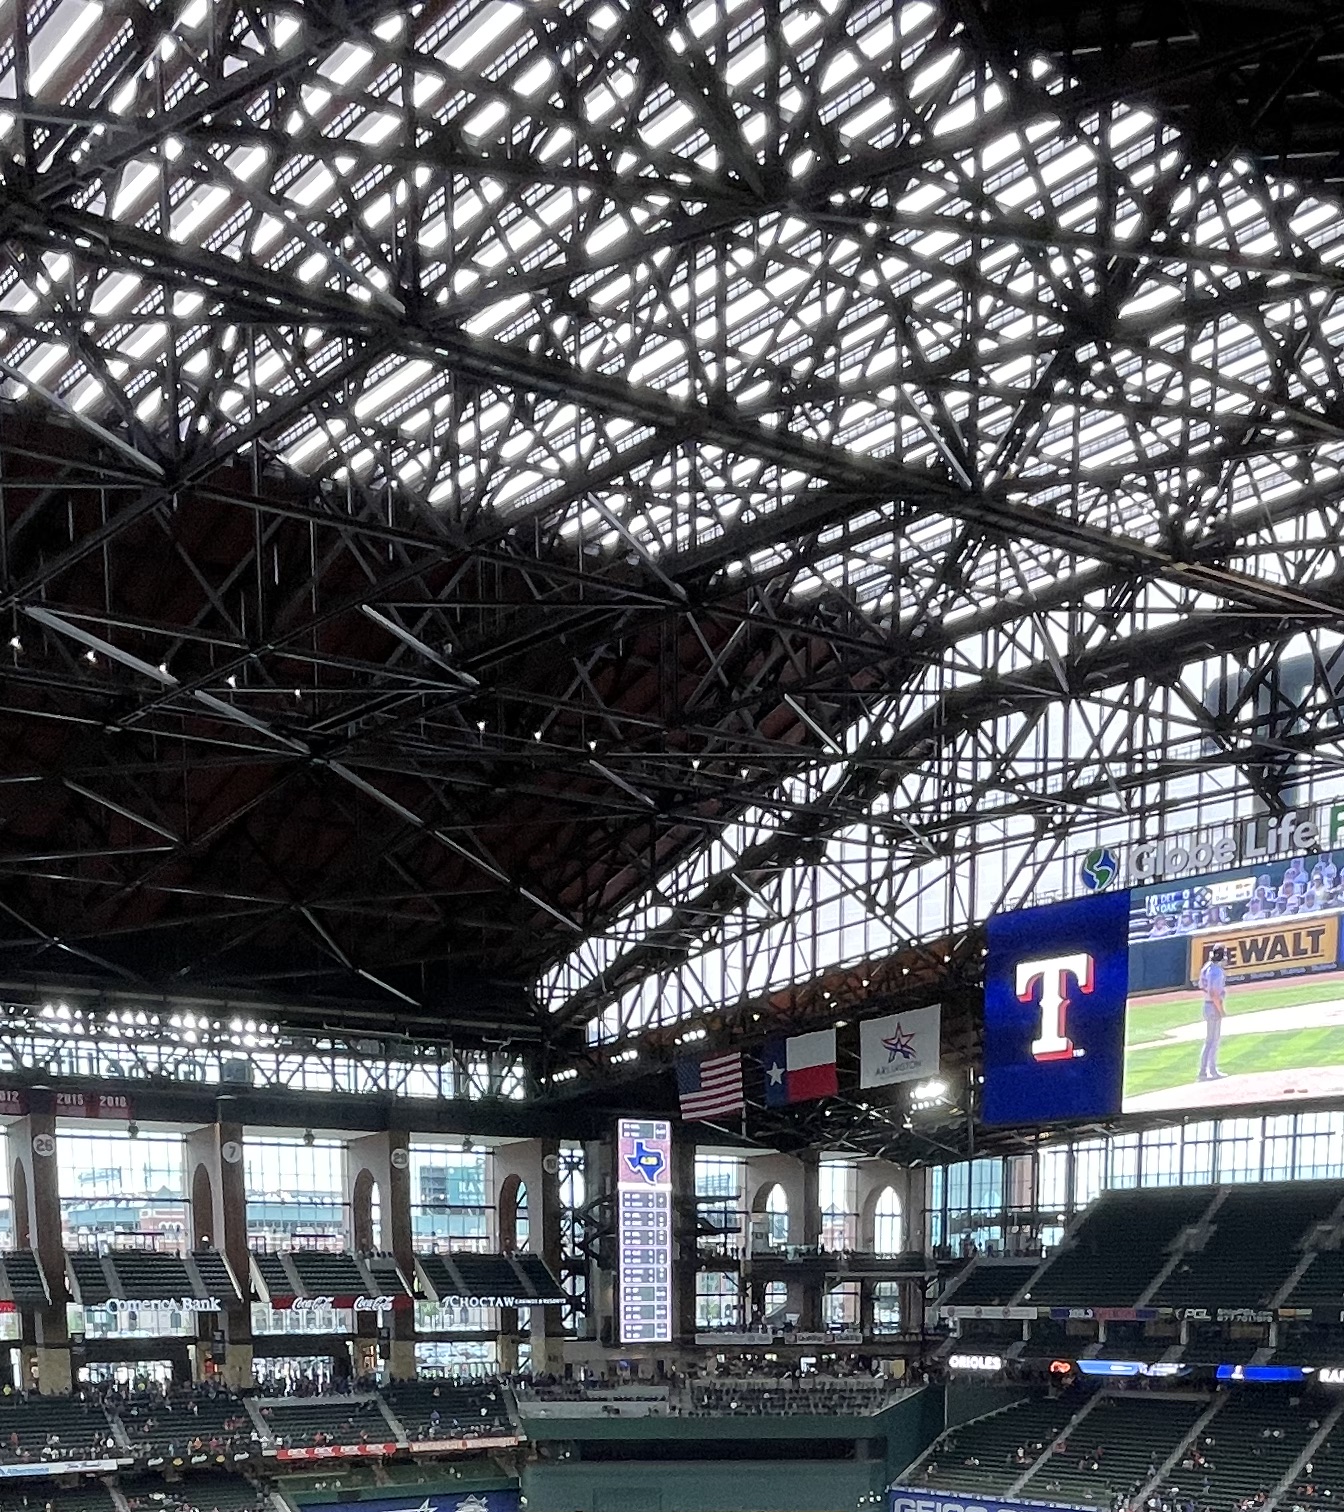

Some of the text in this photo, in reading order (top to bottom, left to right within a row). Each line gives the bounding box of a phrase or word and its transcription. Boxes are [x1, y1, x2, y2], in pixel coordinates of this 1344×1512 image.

[1129, 836, 1236, 879] Globe
[1247, 813, 1318, 859] Life
[1016, 952, 1095, 1062] T
[229, 1145, 237, 1158] 7
[182, 1296, 222, 1312] Bank
[449, 1296, 515, 1308] CHOCTAW
[949, 1355, 1003, 1370] ORIOLES
